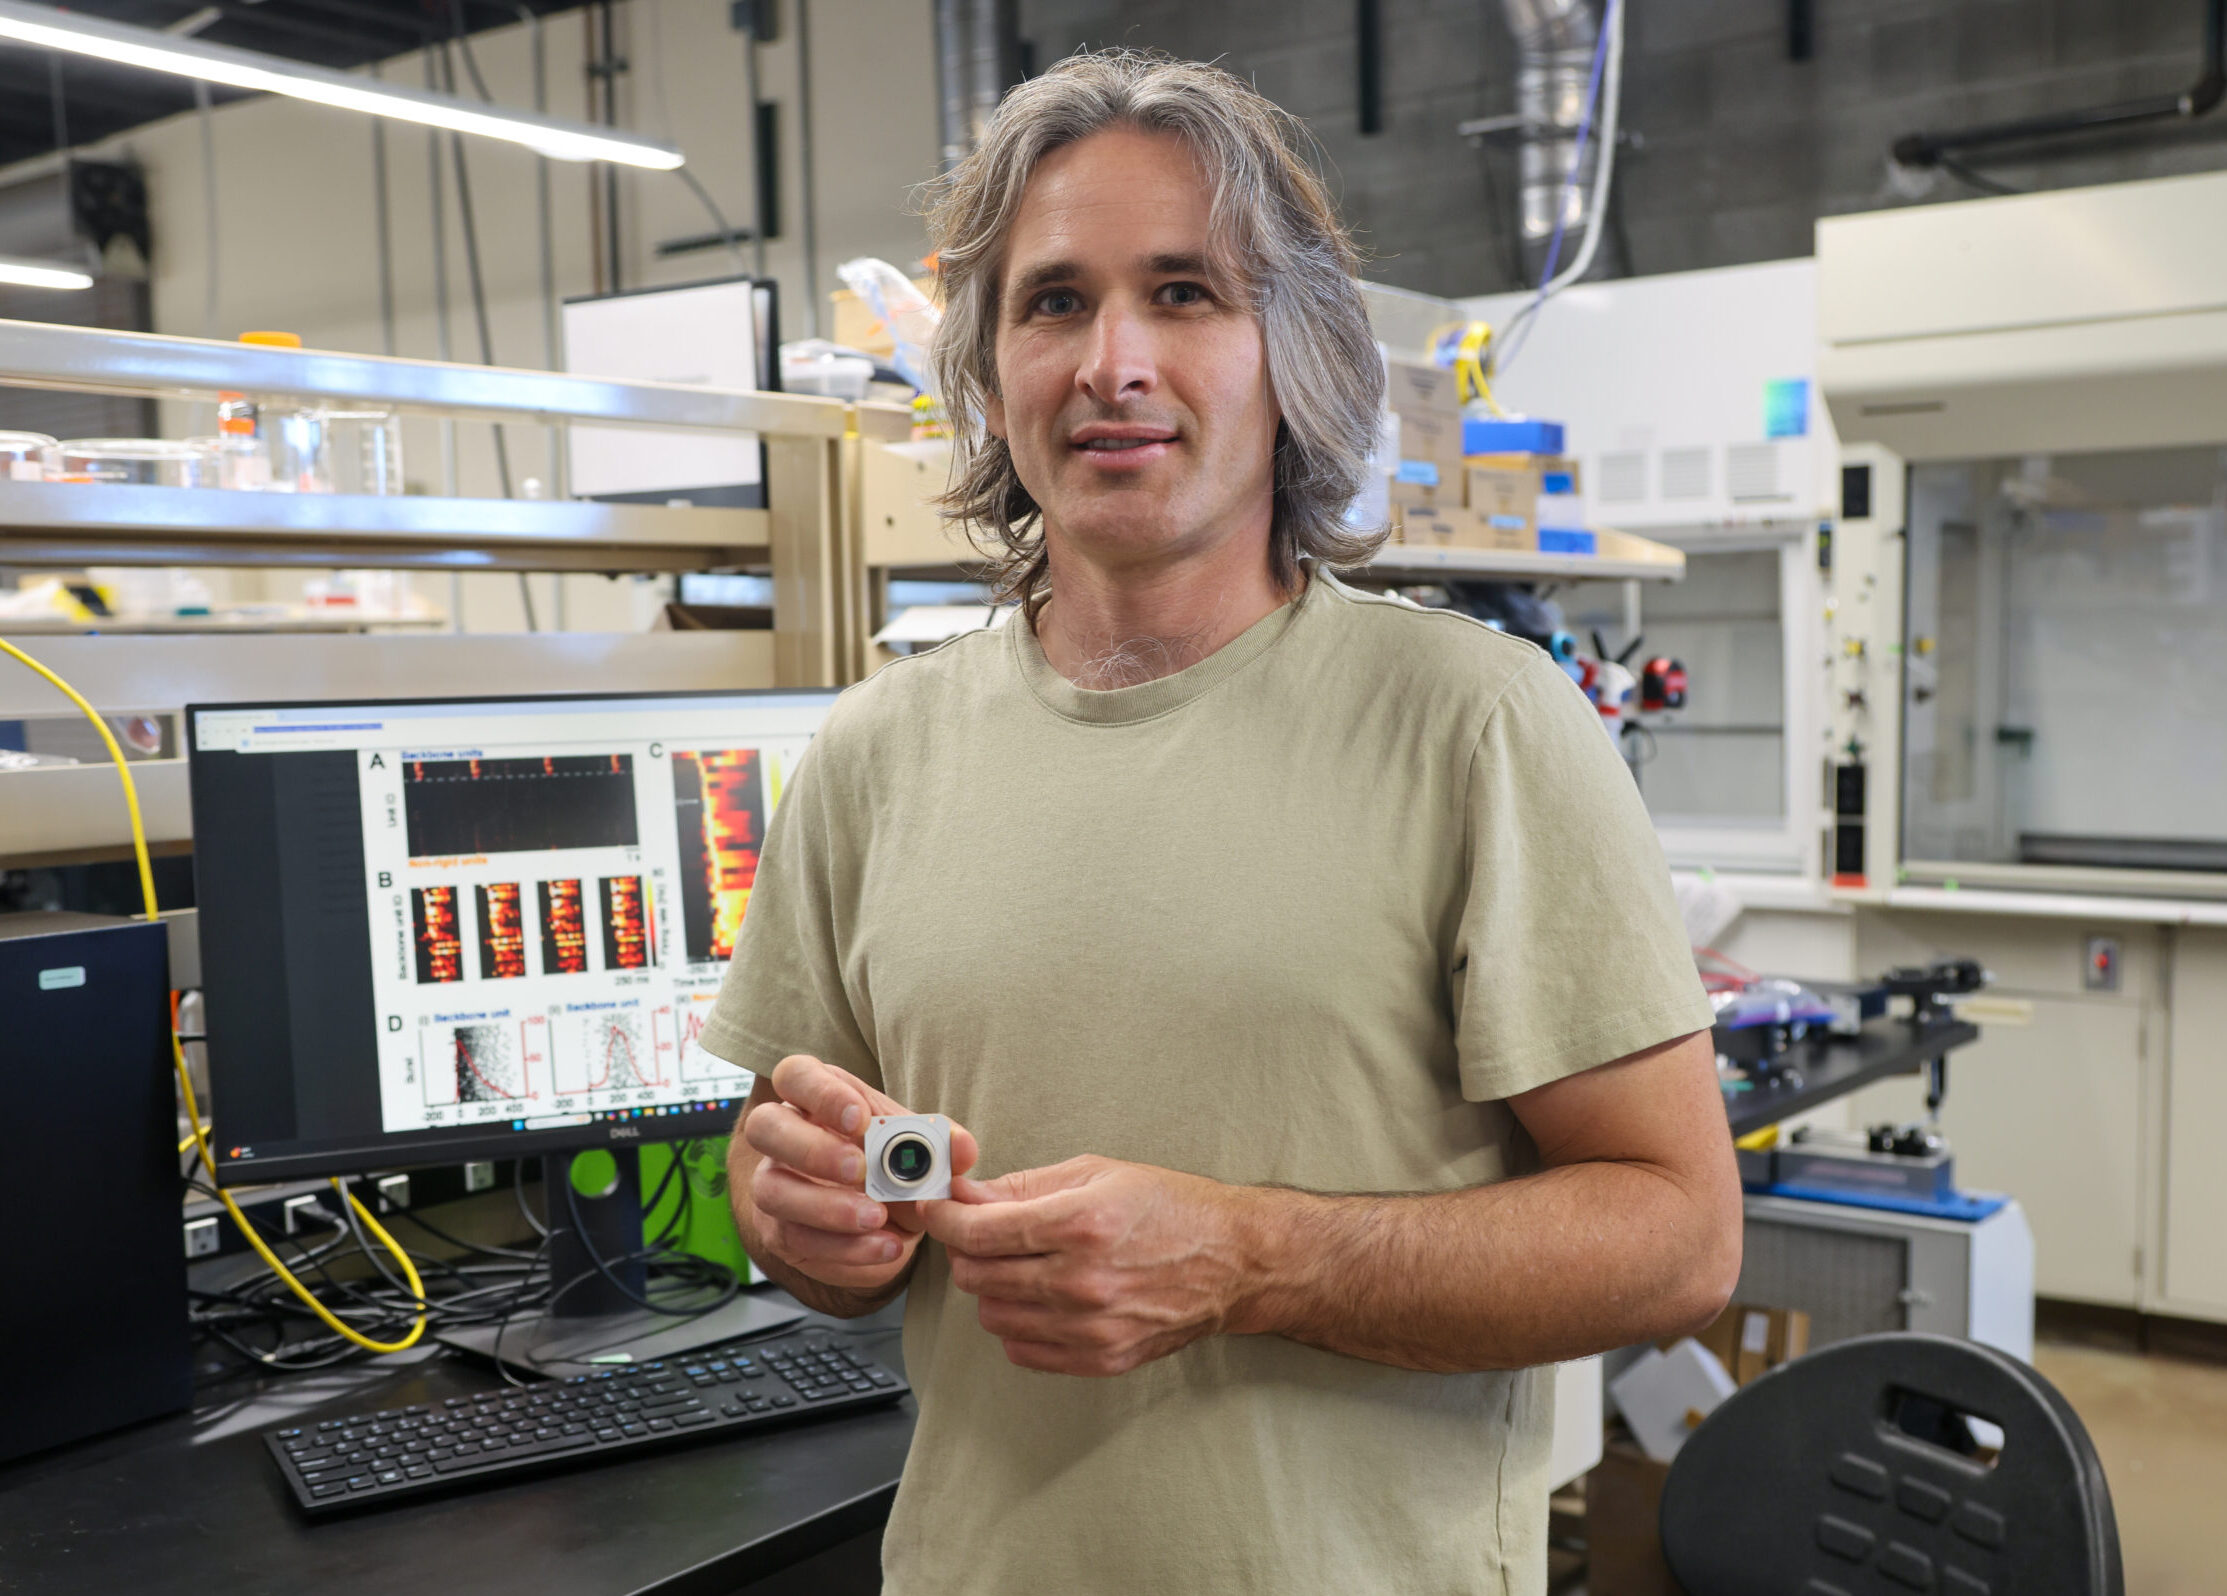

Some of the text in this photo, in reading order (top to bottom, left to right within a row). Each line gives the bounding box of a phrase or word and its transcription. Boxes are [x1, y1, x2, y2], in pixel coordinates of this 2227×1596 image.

[649, 743, 663, 758] C
[370, 753, 385, 770] A
[378, 872, 393, 888] B
[566, 1000, 616, 1012] Backbone
[435, 1011, 487, 1023] Backbone
[388, 1015, 403, 1032] D
[610, 1093, 627, 1103] 200
[637, 1091, 654, 1101] 400
[478, 1106, 496, 1116] 200
[505, 1104, 523, 1113] 400
[610, 1126, 640, 1139] DELL
